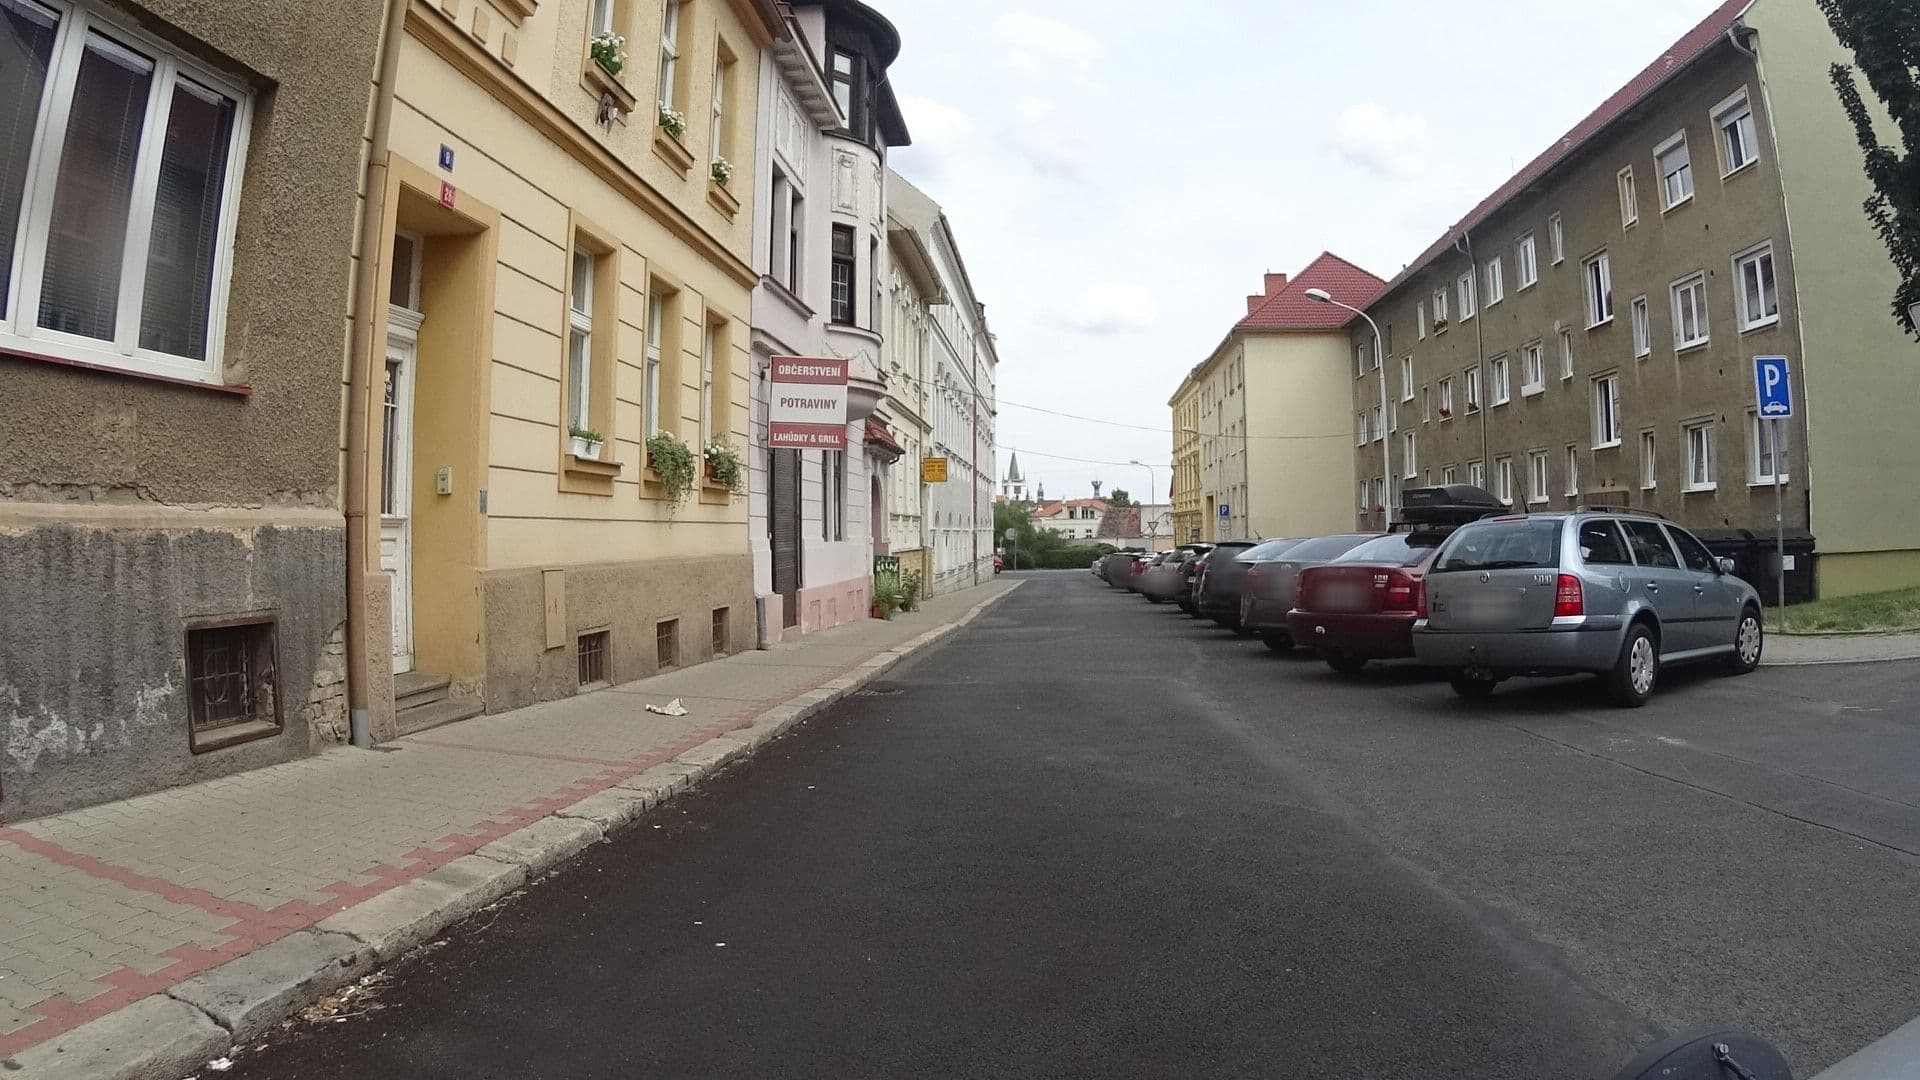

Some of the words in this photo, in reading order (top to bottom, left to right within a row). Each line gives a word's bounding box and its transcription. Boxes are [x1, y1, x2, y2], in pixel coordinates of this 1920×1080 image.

[778, 363, 841, 377] OBČERSTVENÍ
[1763, 364, 1780, 398] P
[780, 397, 837, 410] POTRAVINY
[773, 430, 808, 442] LAHŮDKY
[810, 434, 816, 443] &
[818, 434, 840, 444] GRILL
[1221, 505, 1228, 515] P
